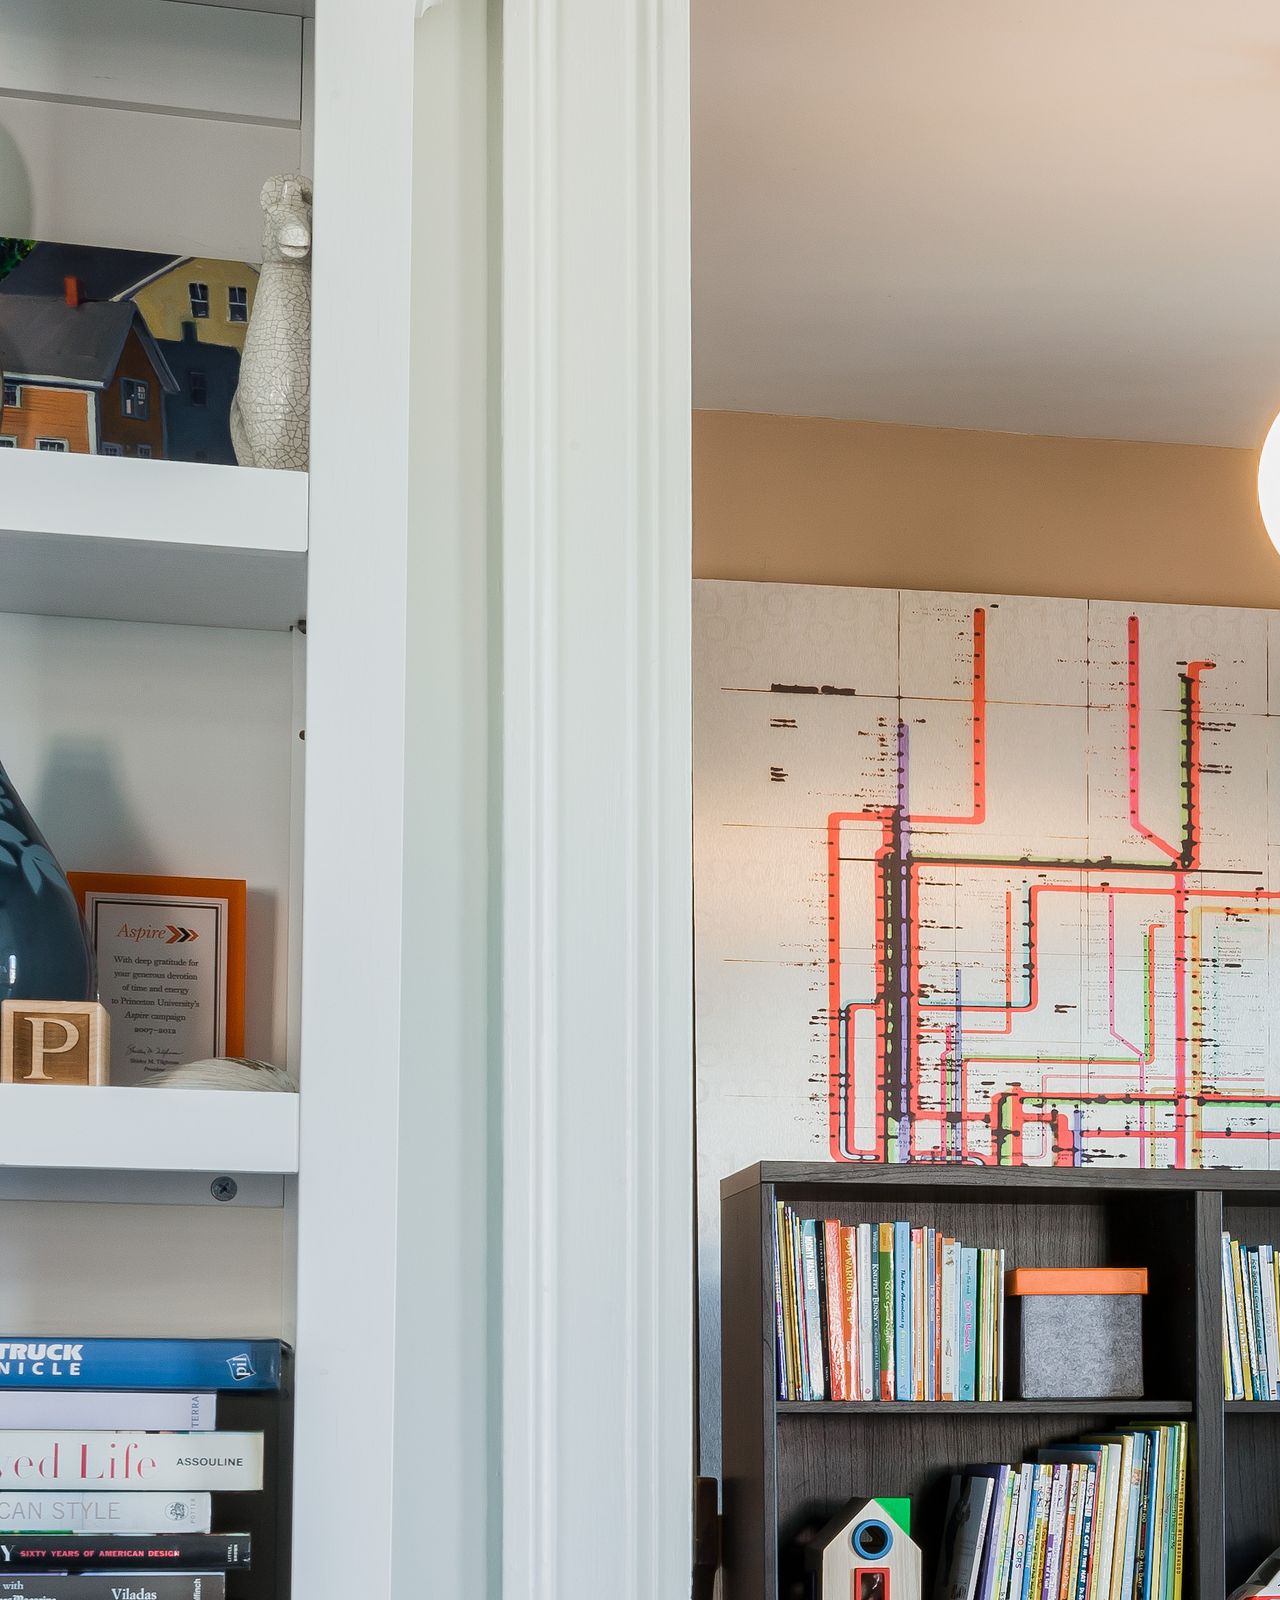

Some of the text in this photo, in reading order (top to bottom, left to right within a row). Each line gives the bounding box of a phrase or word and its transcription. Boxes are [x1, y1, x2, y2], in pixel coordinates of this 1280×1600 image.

[117, 922, 166, 942] Aspire
[114, 955, 198, 967] With deep gratitude for
[114, 970, 130, 978] your
[133, 972, 165, 980] generous
[131, 984, 147, 992] time
[149, 985, 162, 993] and
[164, 987, 190, 996] energy
[24, 1017, 80, 1080] P
[191, 1396, 200, 1429] TERRA
[80, 1442, 157, 1479] Life
[176, 1457, 244, 1467] ASSOULINE
[52, 1502, 121, 1520] STYLE
[99, 1549, 144, 1557] AMERICAN
[148, 1549, 180, 1557] DESIGN
[3, 1580, 24, 1590] with
[112, 1587, 157, 1600] Viladas
